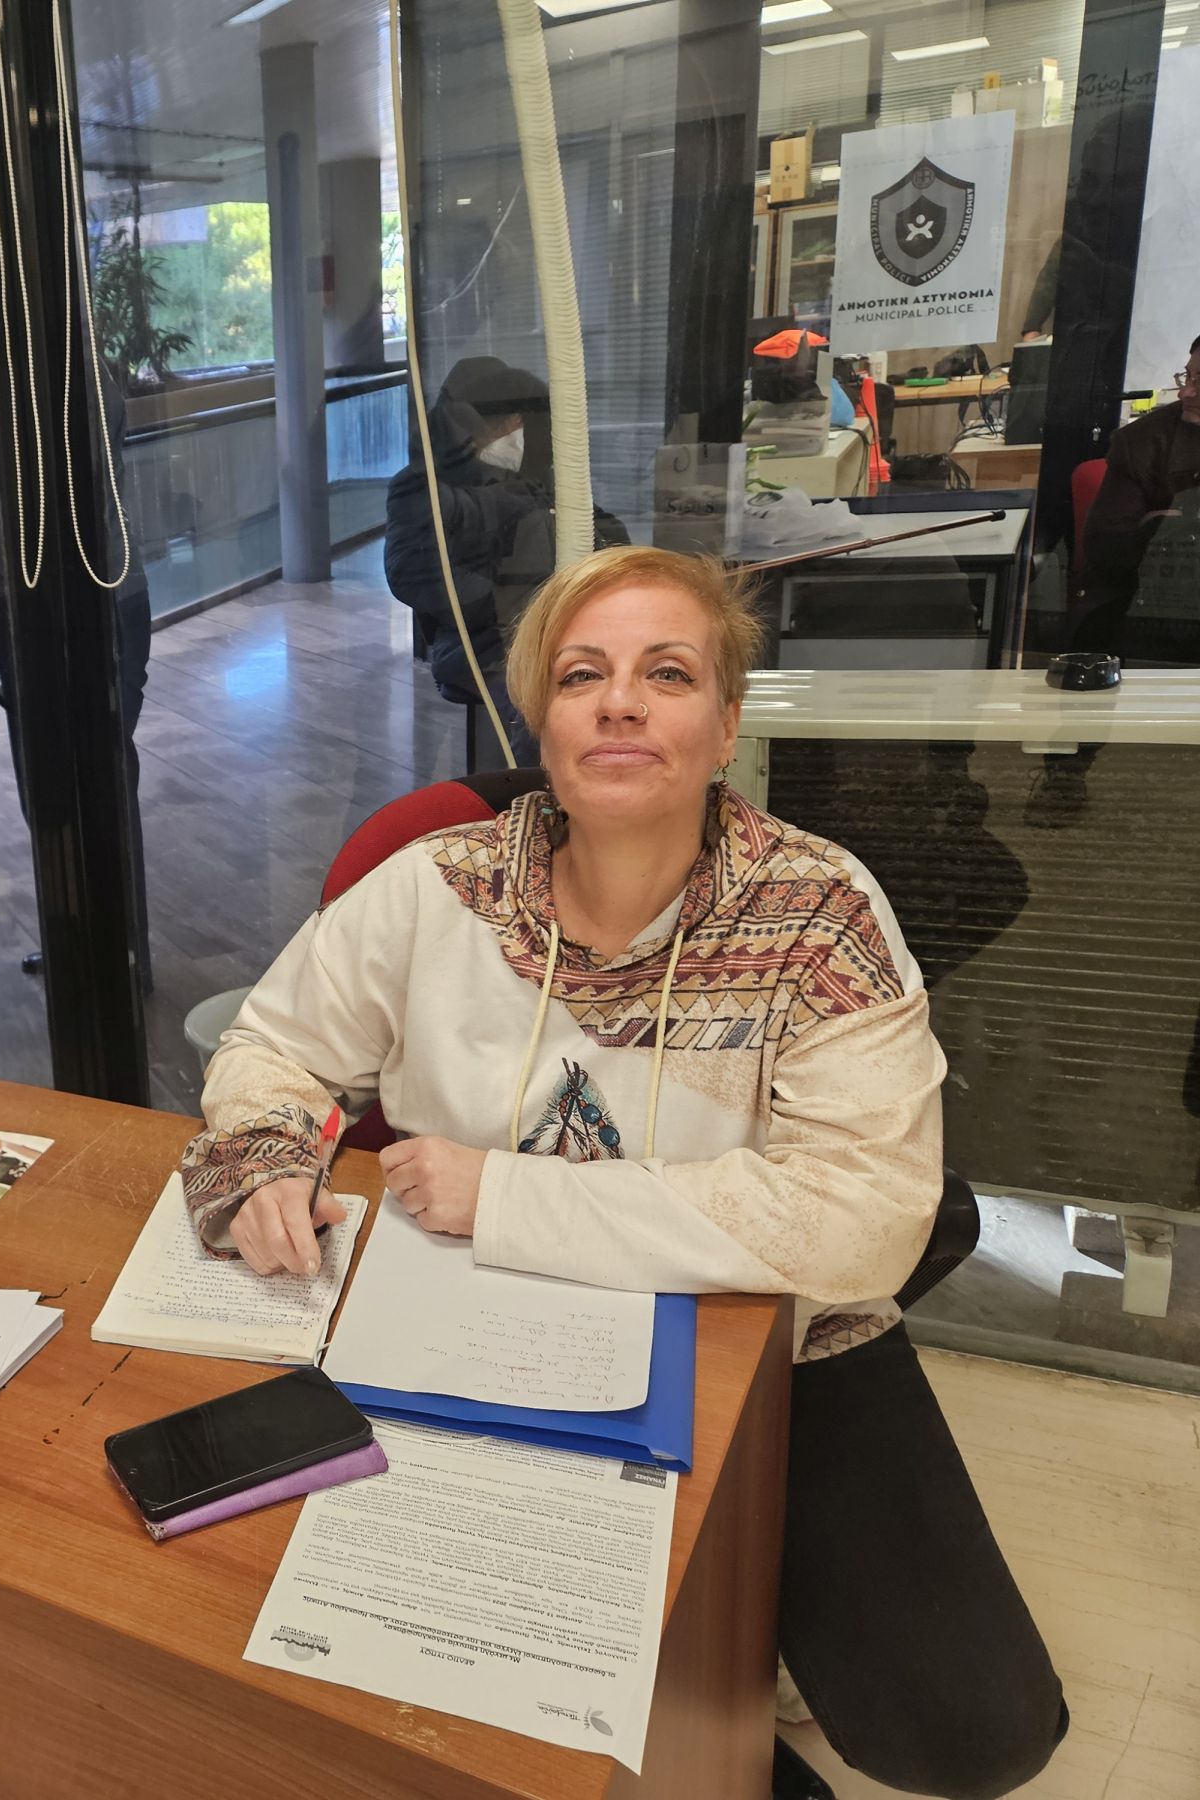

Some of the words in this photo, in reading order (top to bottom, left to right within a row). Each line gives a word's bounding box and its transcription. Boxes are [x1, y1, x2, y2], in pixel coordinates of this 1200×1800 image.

[838, 297, 908, 311] ΔΗΜΟΤΙΚΗ
[913, 288, 994, 305] ΑΣΤΥΝΟΜΙΑ
[855, 309, 922, 323] MUNICIPAL
[927, 304, 974, 317] POLICE
